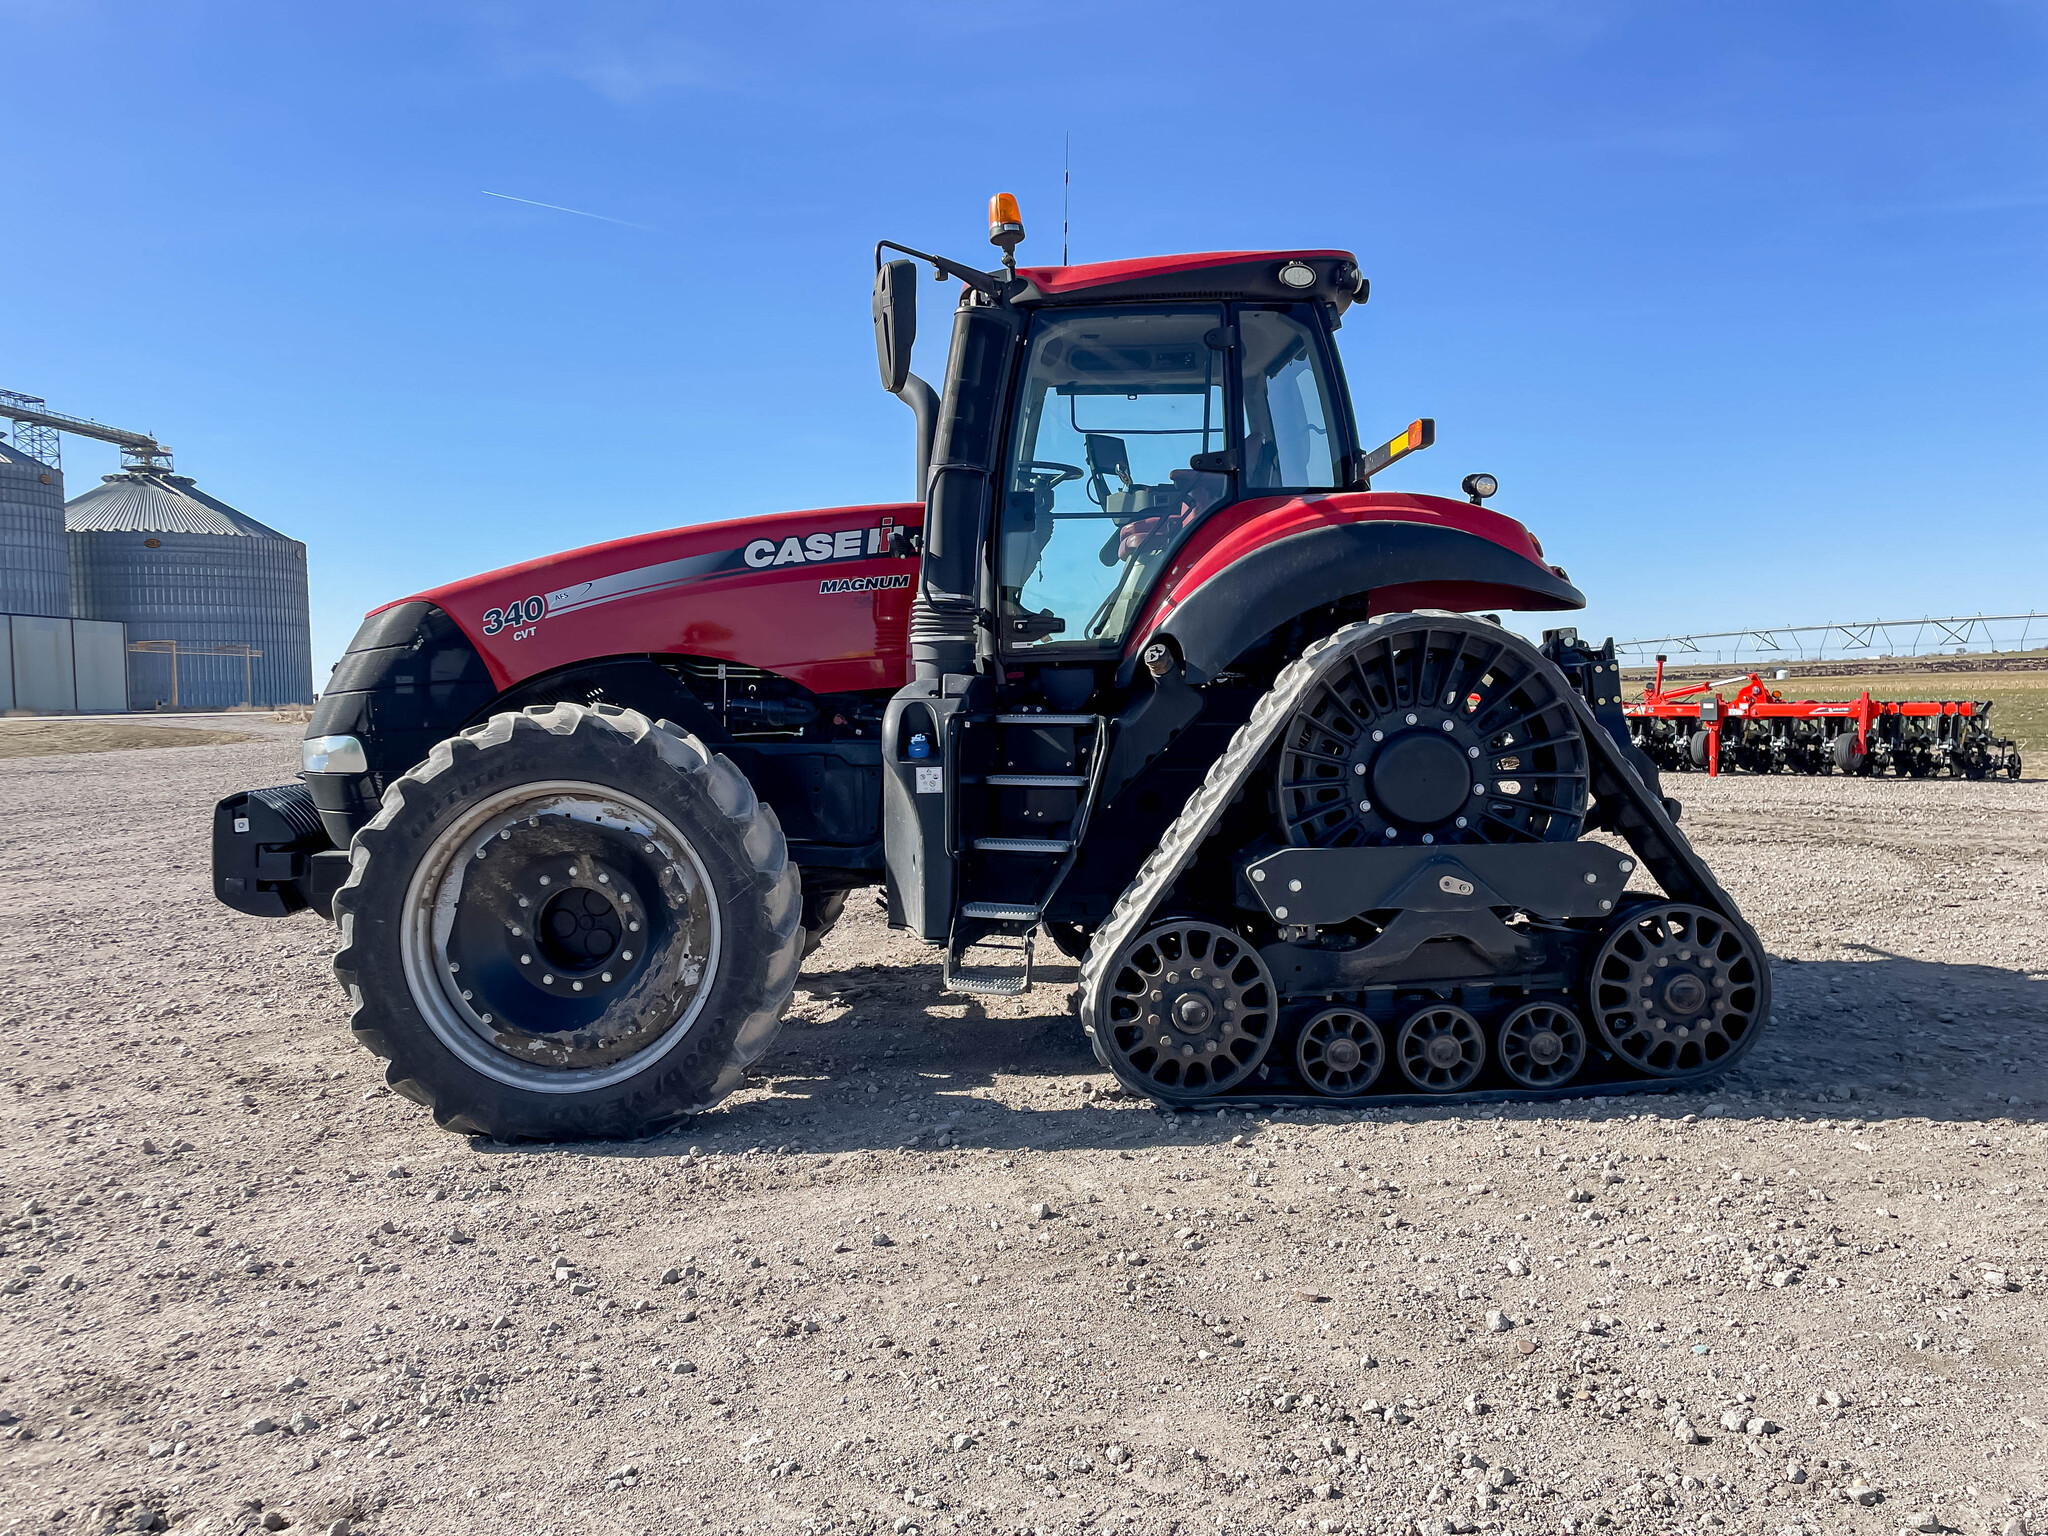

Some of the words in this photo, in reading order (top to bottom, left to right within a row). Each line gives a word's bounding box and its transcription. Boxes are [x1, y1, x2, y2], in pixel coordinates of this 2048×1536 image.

[744, 530, 863, 568] CASE
[818, 574, 911, 595] MAGNUM
[482, 595, 545, 636] 340
[513, 626, 537, 641] CVT
